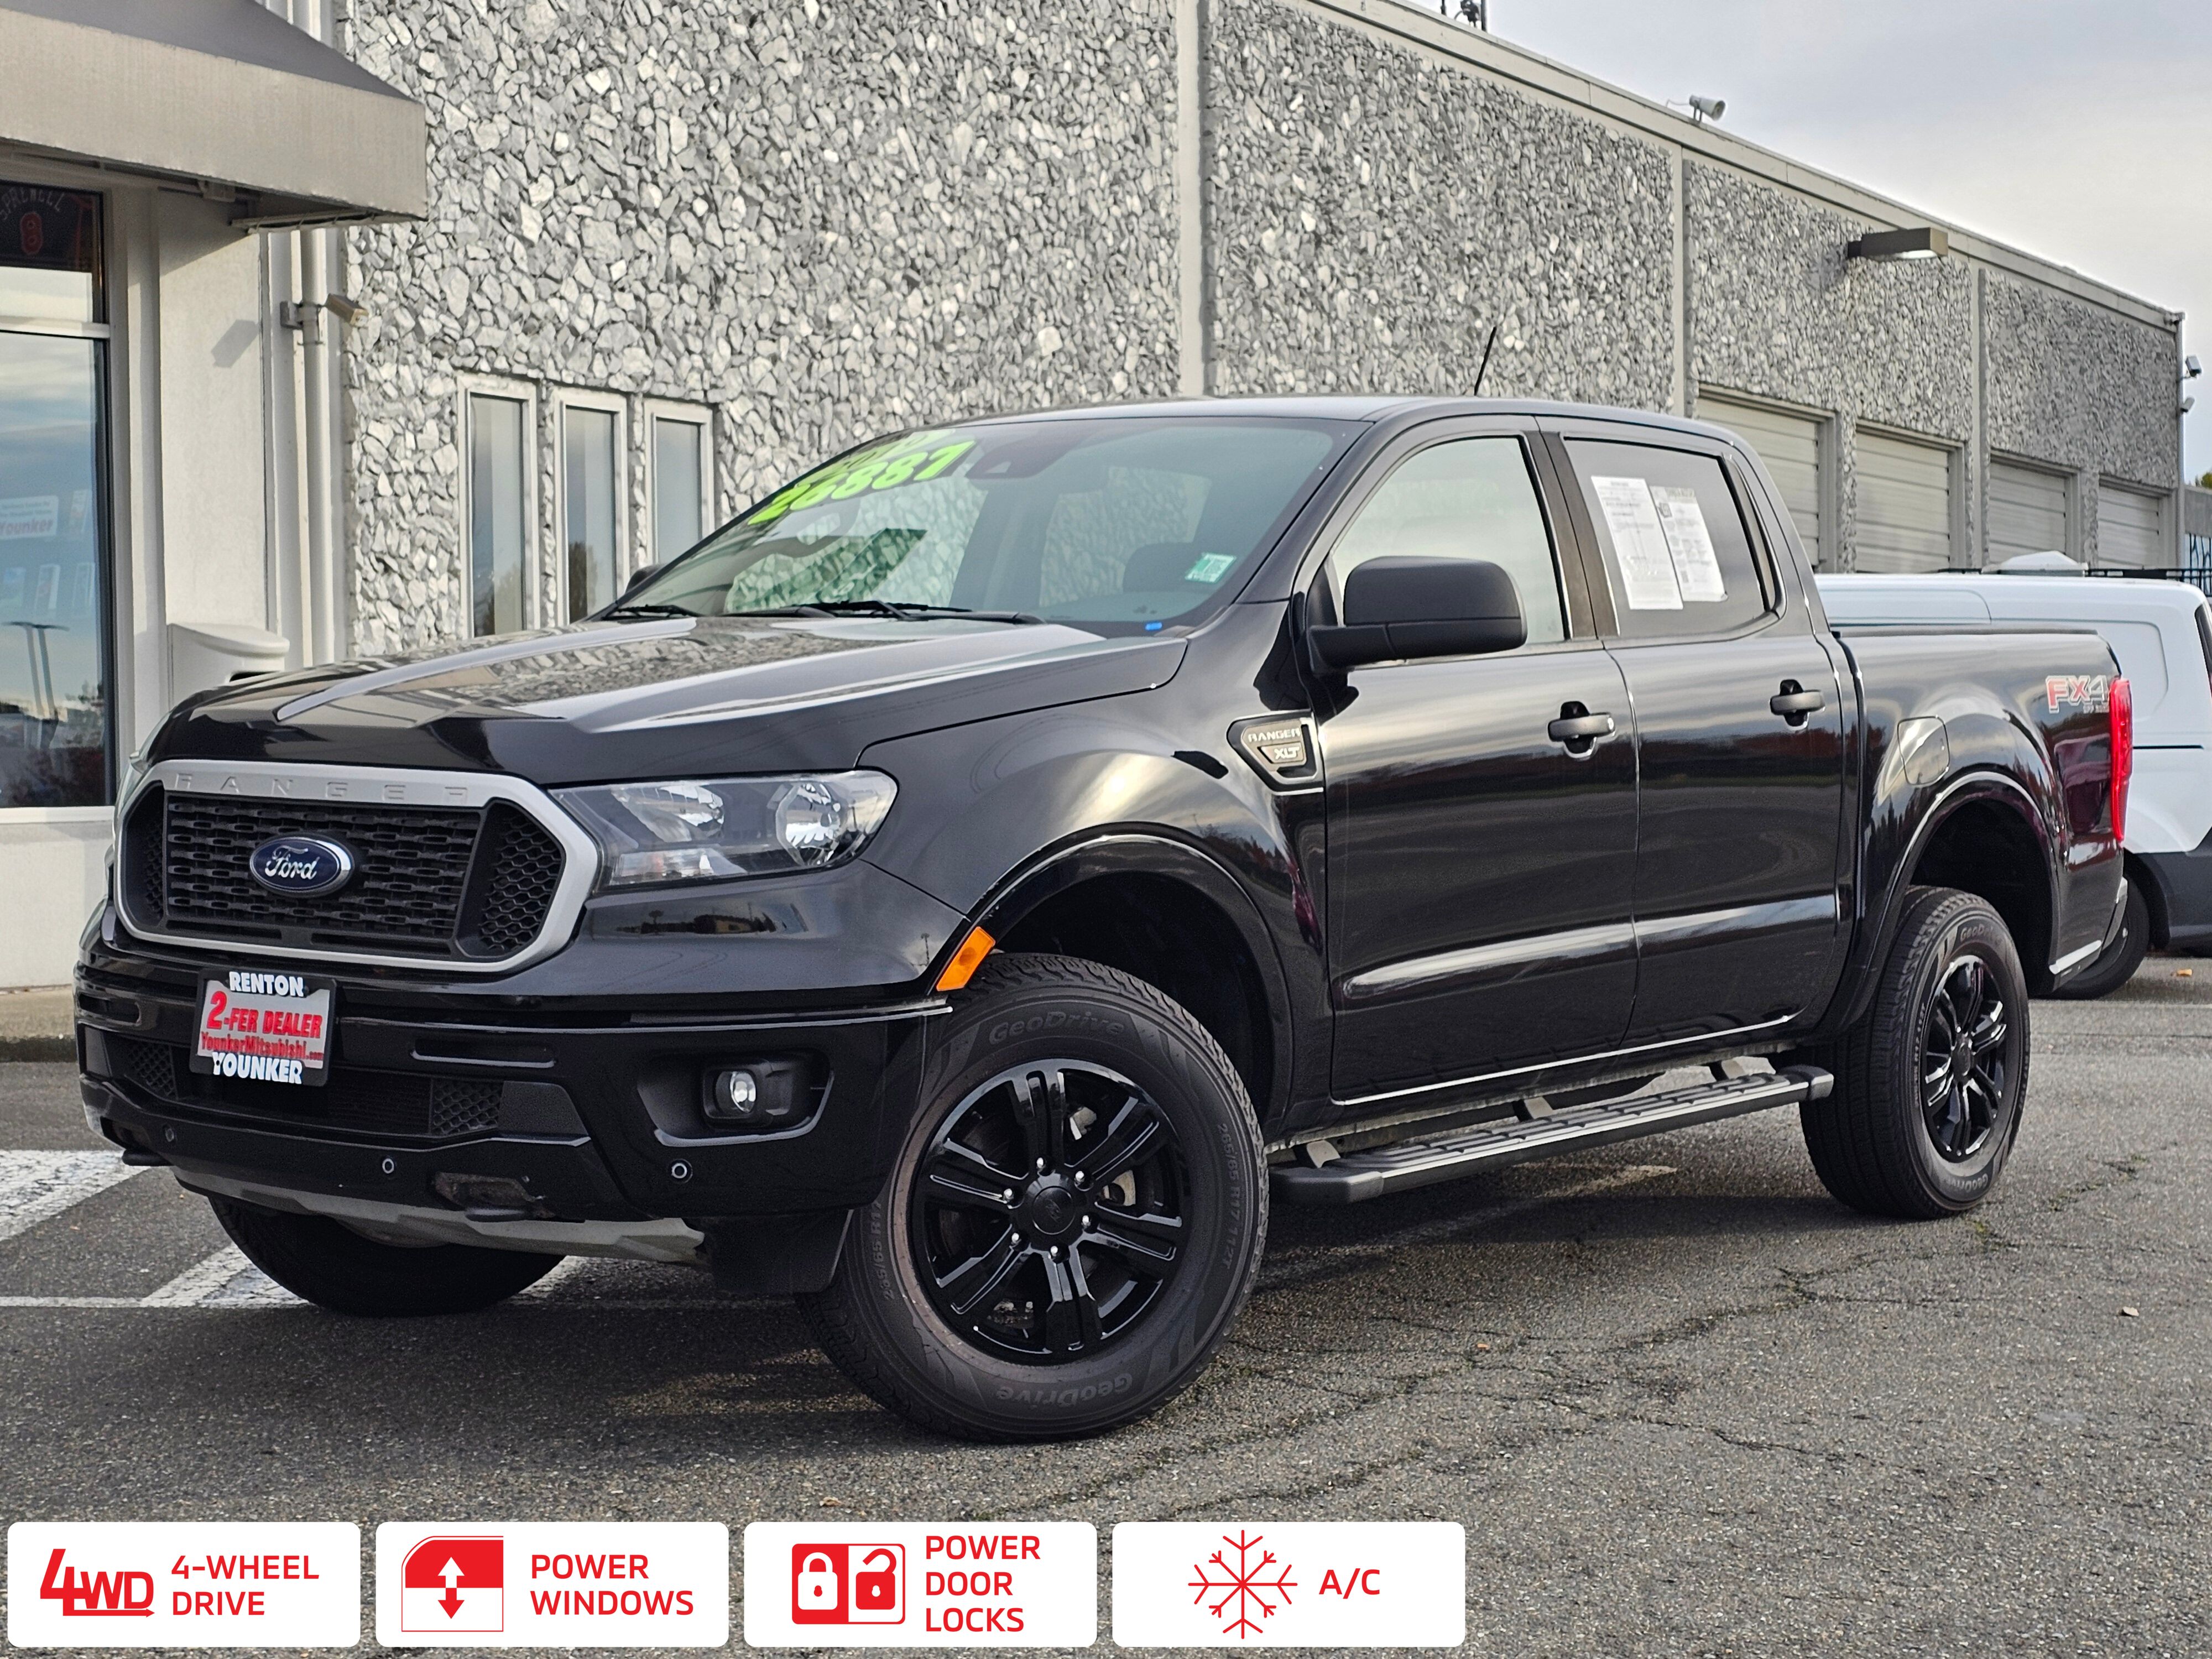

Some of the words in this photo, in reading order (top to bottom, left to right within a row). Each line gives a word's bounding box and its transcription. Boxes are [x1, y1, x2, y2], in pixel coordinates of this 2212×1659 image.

[2046, 674, 2110, 714] FX4
[1248, 728, 1301, 742] RANGER
[1274, 746, 1301, 760] XLT
[174, 773, 468, 804] RANGER
[264, 844, 321, 880] Ford
[229, 971, 304, 997] RENTON
[206, 990, 259, 1032] 2-FER
[262, 1010, 323, 1039] DEALER
[989, 1011, 1124, 1045] GeoDrive
[212, 1052, 303, 1084] YOUNKER
